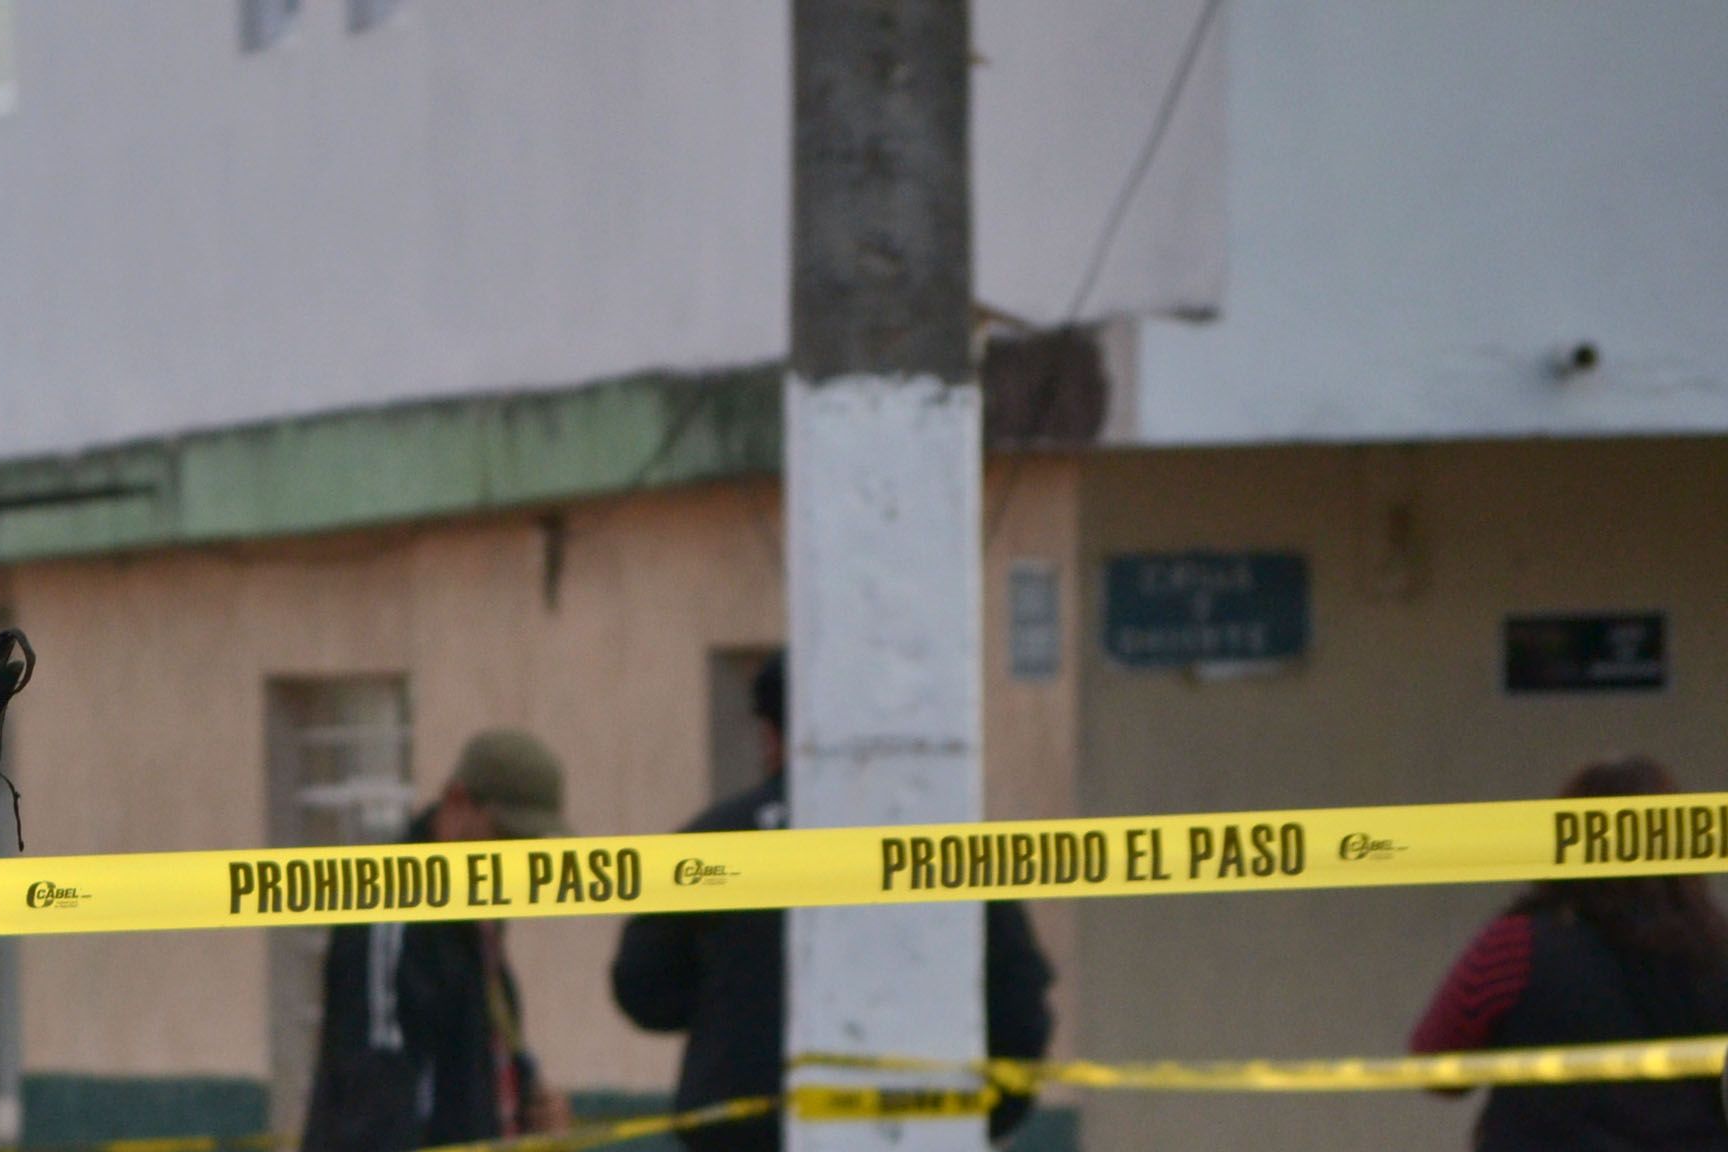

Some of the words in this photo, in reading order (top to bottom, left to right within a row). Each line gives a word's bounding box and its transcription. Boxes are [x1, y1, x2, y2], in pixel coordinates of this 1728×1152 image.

[882, 829, 1109, 891] PROHIBIDO
[1125, 828, 1170, 882] EL
[1189, 821, 1305, 880] PASO
[1555, 805, 1728, 865] PROHIBI
[228, 853, 451, 915] PROHIBIDO
[466, 852, 512, 906] EL
[528, 847, 643, 904] PASO
